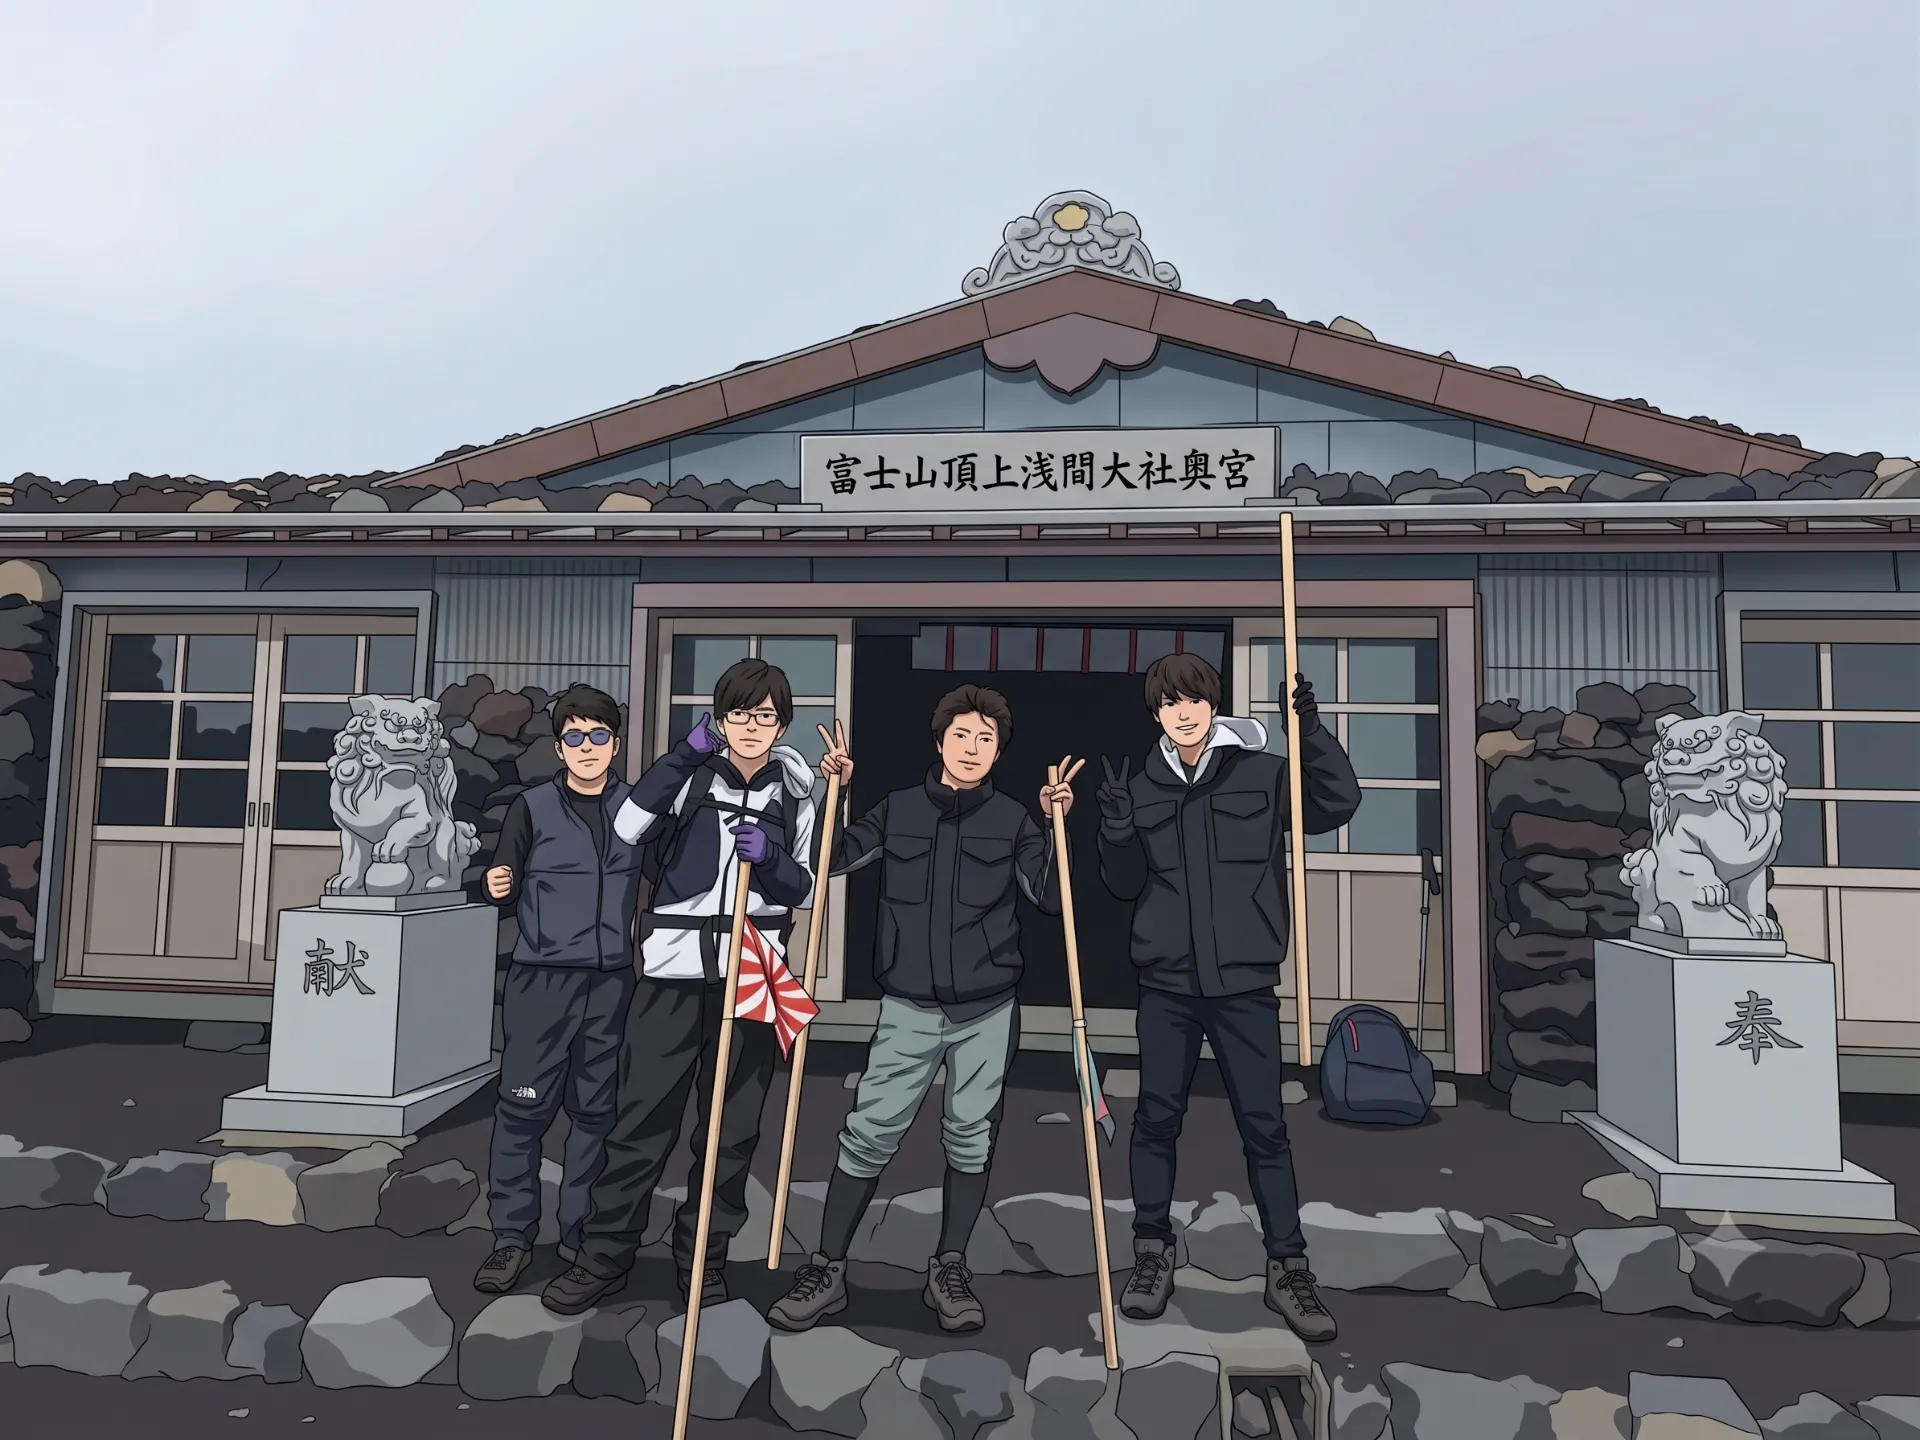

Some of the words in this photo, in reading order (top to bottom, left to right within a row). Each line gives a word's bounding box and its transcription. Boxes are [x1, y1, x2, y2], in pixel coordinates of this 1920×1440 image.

[825, 448, 1256, 495] 富士山頂上浅間大社奥宮
[303, 937, 376, 997] 献
[1715, 990, 1804, 1065] 奉
